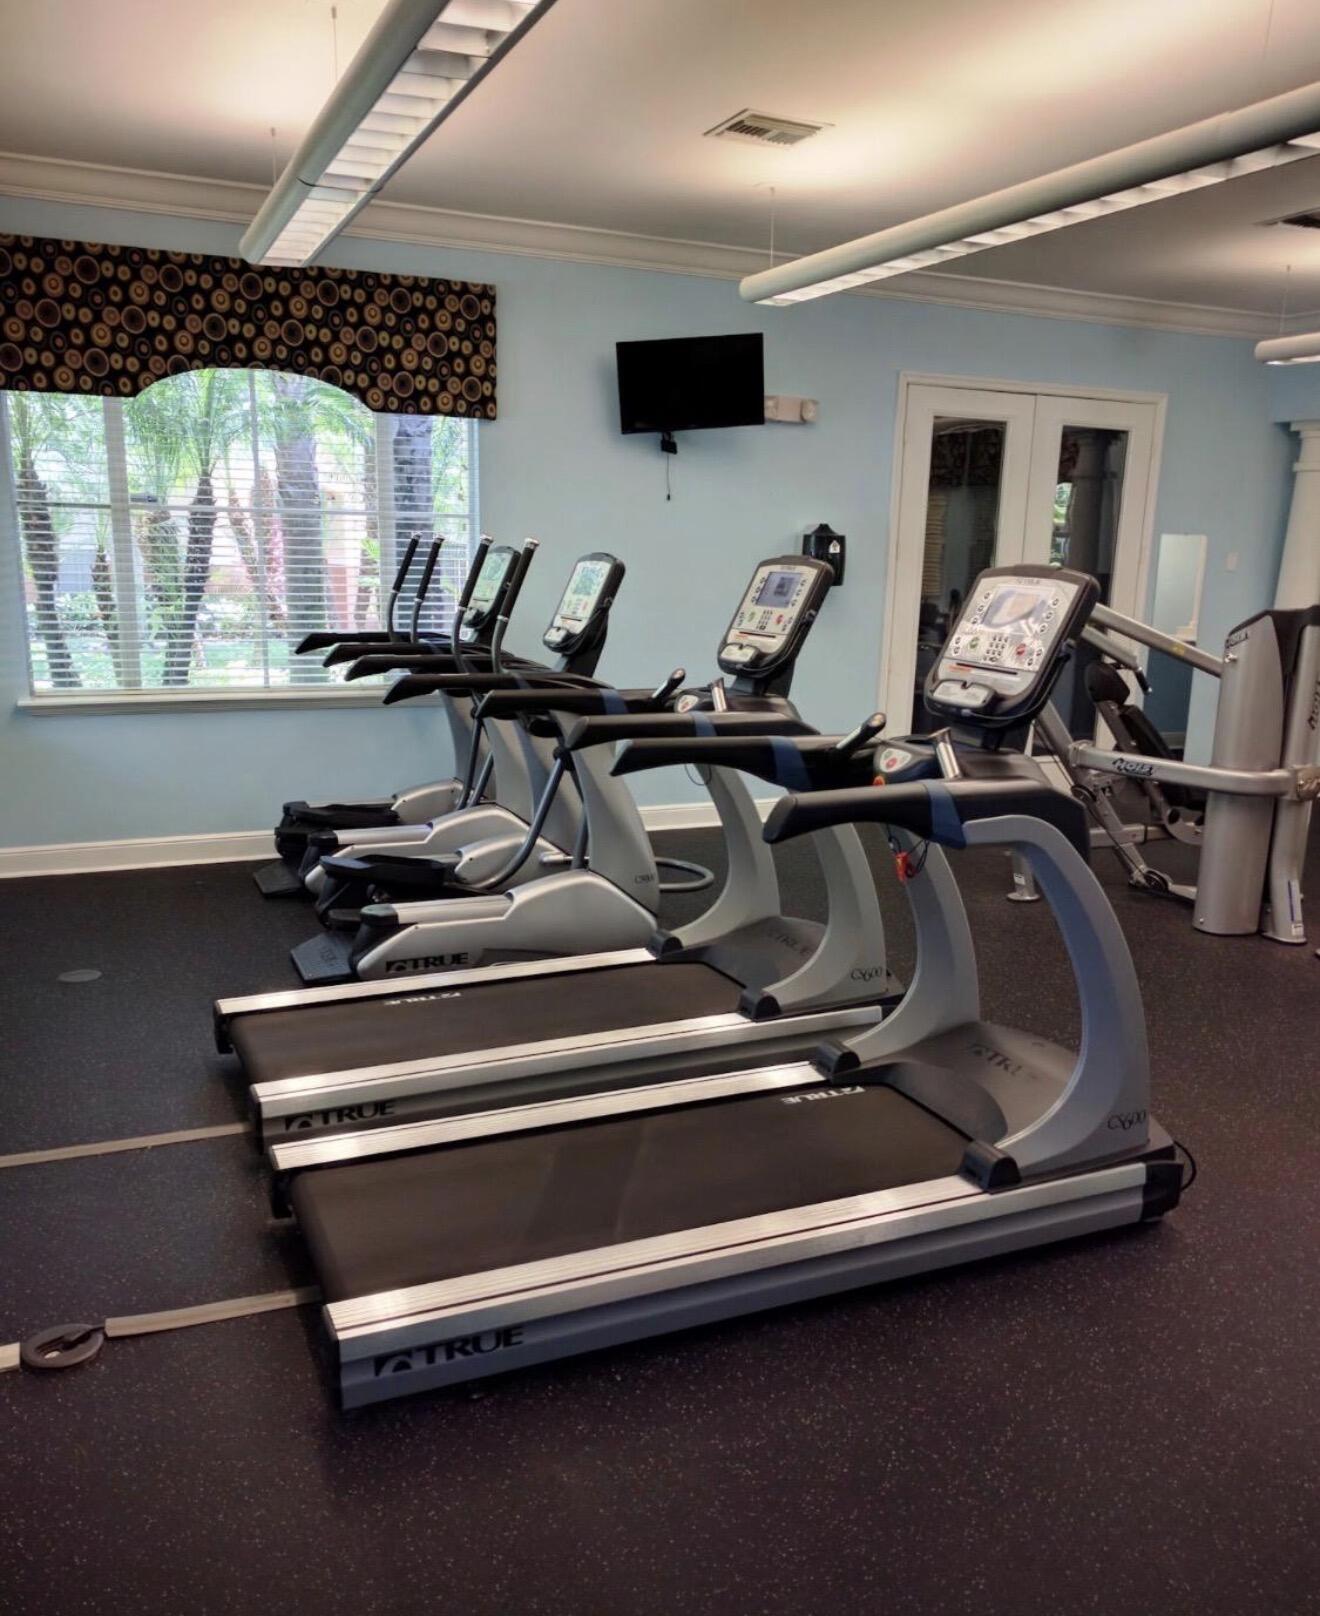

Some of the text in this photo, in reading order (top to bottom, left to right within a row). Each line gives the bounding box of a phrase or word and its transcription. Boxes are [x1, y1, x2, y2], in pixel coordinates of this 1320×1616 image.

[408, 952, 469, 970] TRUE
[318, 1100, 396, 1126] TRUE
[418, 1326, 524, 1365] TRUE
